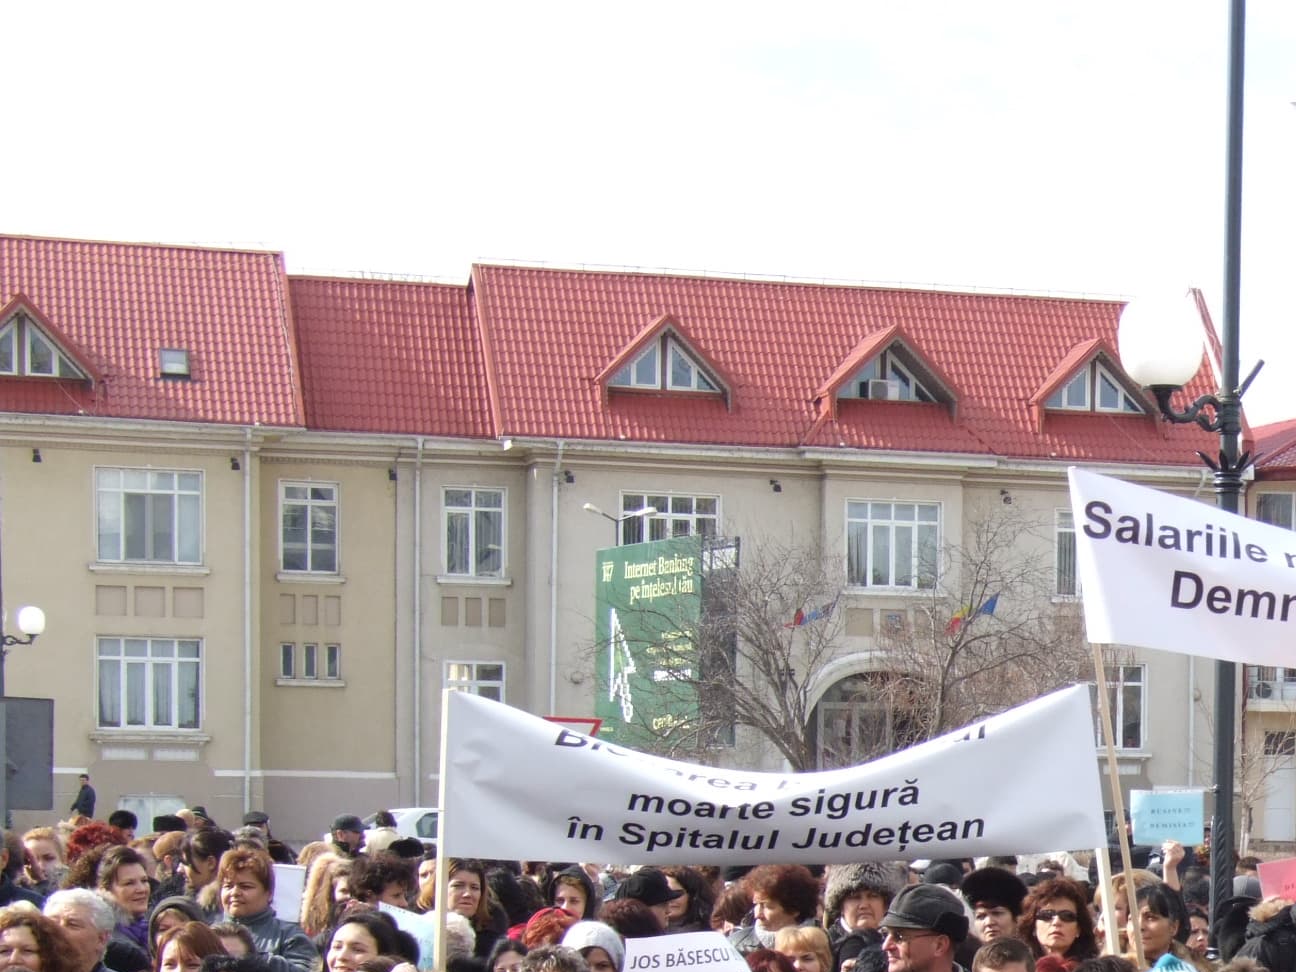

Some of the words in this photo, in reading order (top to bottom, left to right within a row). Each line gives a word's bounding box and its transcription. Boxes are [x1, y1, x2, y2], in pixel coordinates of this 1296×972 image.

[1083, 501, 1268, 563] Salariile
[624, 560, 657, 579] Internet
[658, 554, 694, 576] Banking
[627, 792, 775, 821] moarte
[788, 779, 920, 819] sigură
[566, 816, 604, 841] în
[618, 822, 780, 852] Spitalul
[791, 818, 985, 853] Județean
[630, 954, 660, 970] JOS
[665, 948, 730, 968] BĂSESCU
